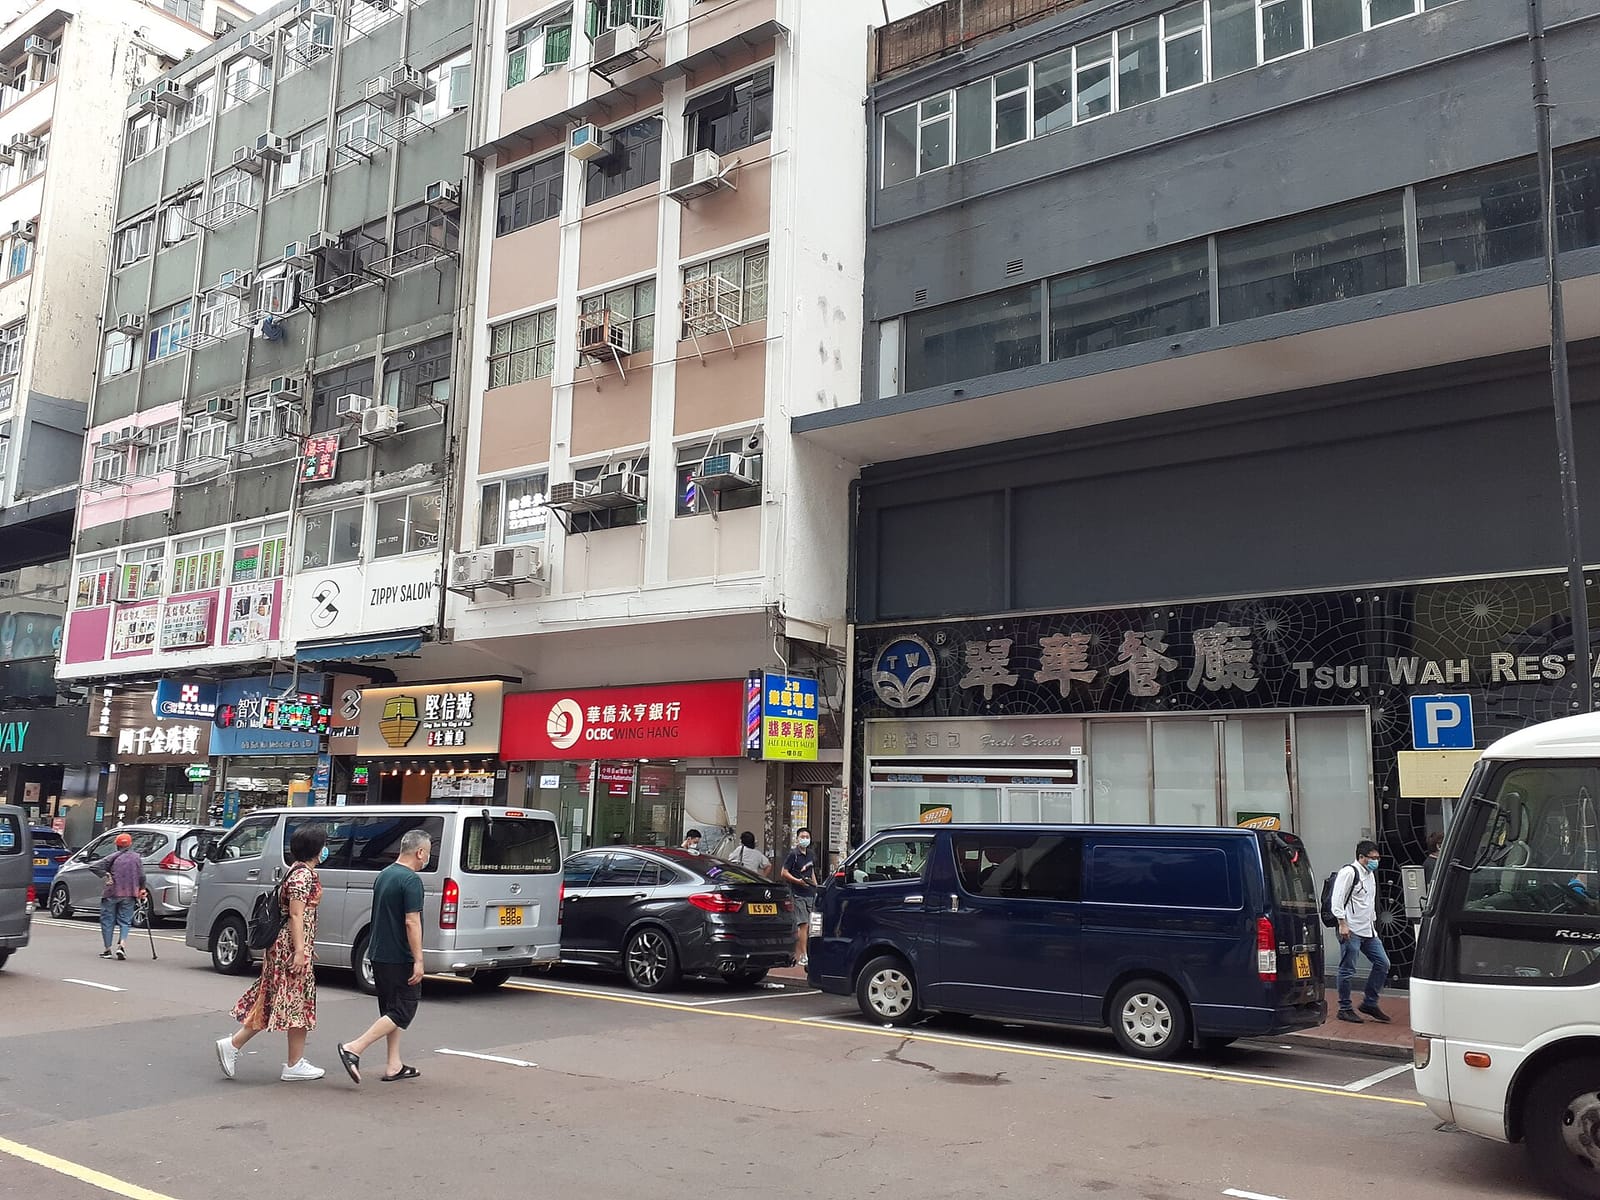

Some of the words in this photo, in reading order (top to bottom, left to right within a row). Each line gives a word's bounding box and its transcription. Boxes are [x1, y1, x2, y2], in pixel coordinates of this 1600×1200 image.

[370, 586, 398, 606] ZIPPY
[400, 581, 432, 602] SALON
[960, 622, 1260, 701] 翠華餐廳
[1292, 661, 1369, 690] TSUI
[1387, 656, 1470, 685] WAH
[1491, 652, 1600, 682] RES
[423, 691, 474, 721] 堅信號
[586, 701, 681, 724] 華僑永亨銀行
[585, 727, 614, 741] OCBC
[614, 727, 644, 740] WING
[646, 725, 679, 739] HANG
[1425, 701, 1462, 745] P
[979, 733, 1016, 747] Fresh
[1020, 733, 1063, 747] Bread
